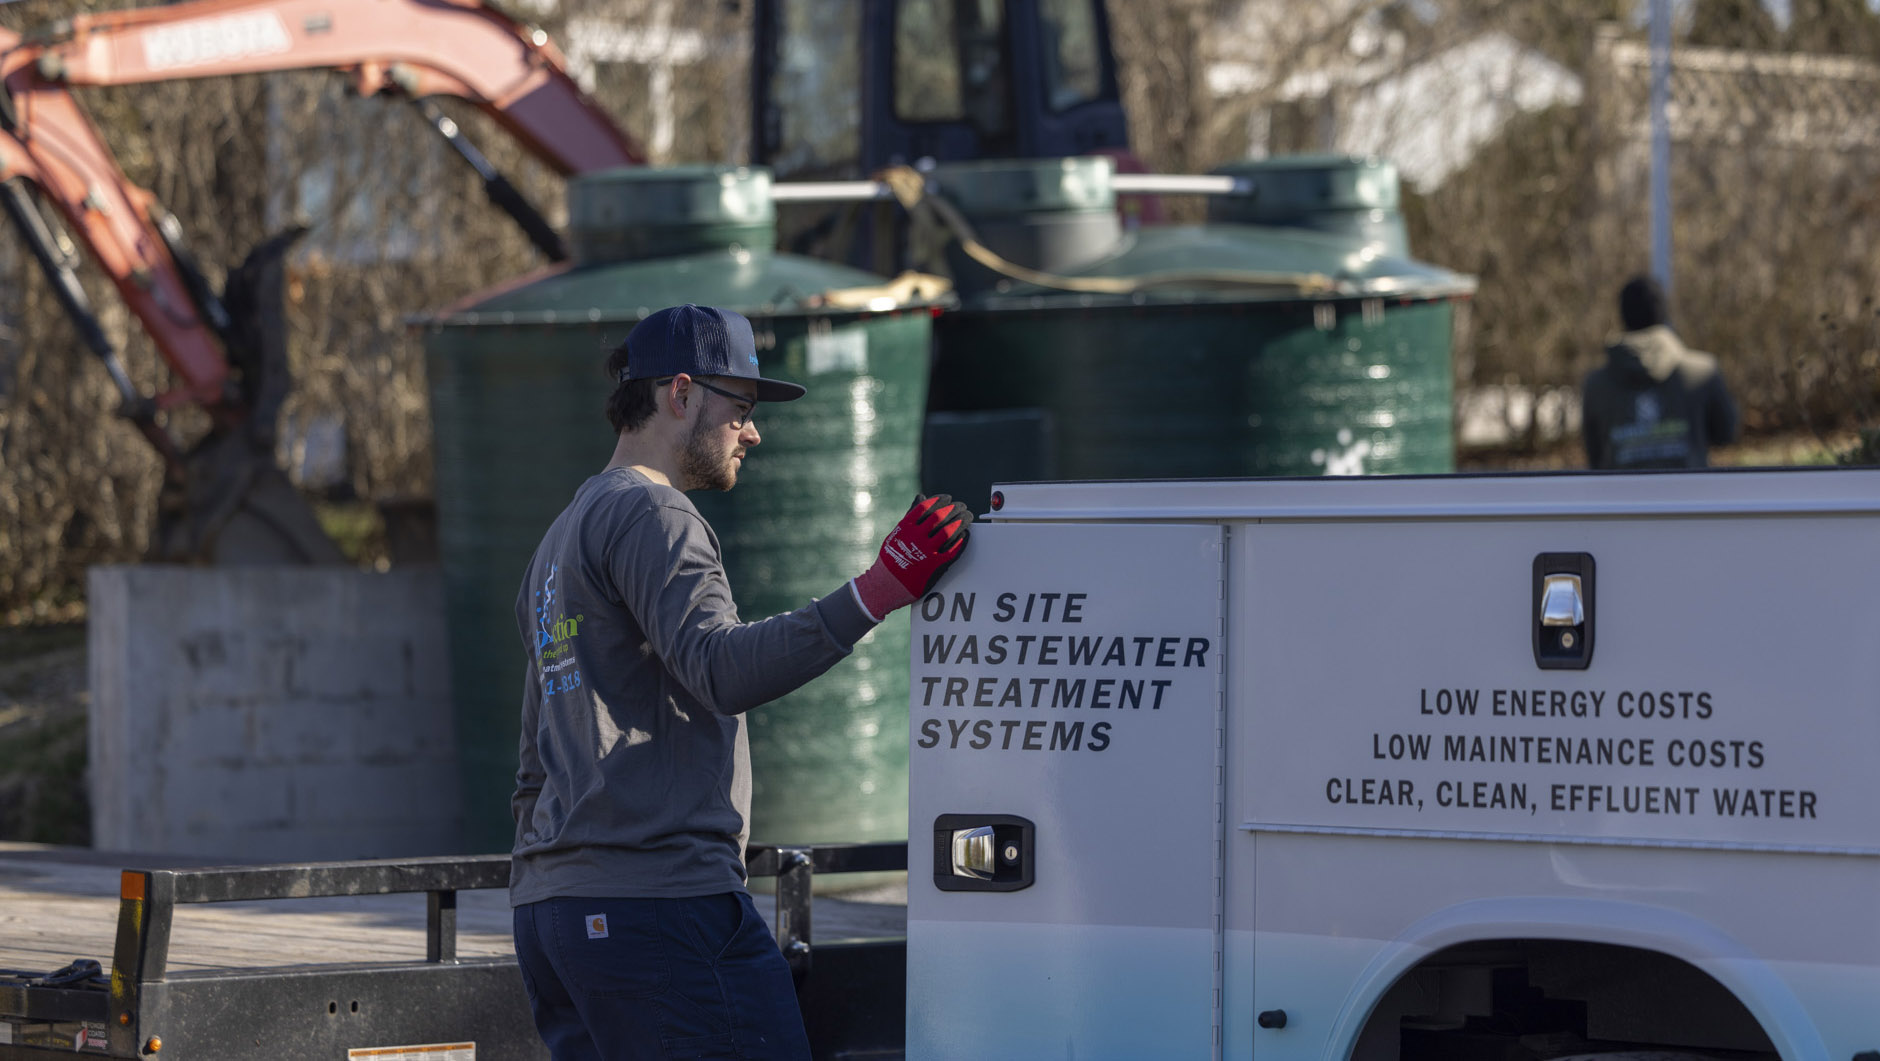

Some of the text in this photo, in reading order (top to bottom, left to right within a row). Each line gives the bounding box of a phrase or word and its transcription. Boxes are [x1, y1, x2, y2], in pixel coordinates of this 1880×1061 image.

[921, 592, 1087, 622] ON SITE
[923, 635, 1210, 667] WASTEWATER
[922, 677, 1172, 709] TREATMENT
[1421, 689, 1713, 719] LOW ENERGY COSTS
[917, 719, 1112, 752] SYSTEMS
[1374, 734, 1765, 768] LOW MAINTENANCE COSTS
[1326, 778, 1817, 819] CLEAR, CLEAN, EFFLUENT WATER
